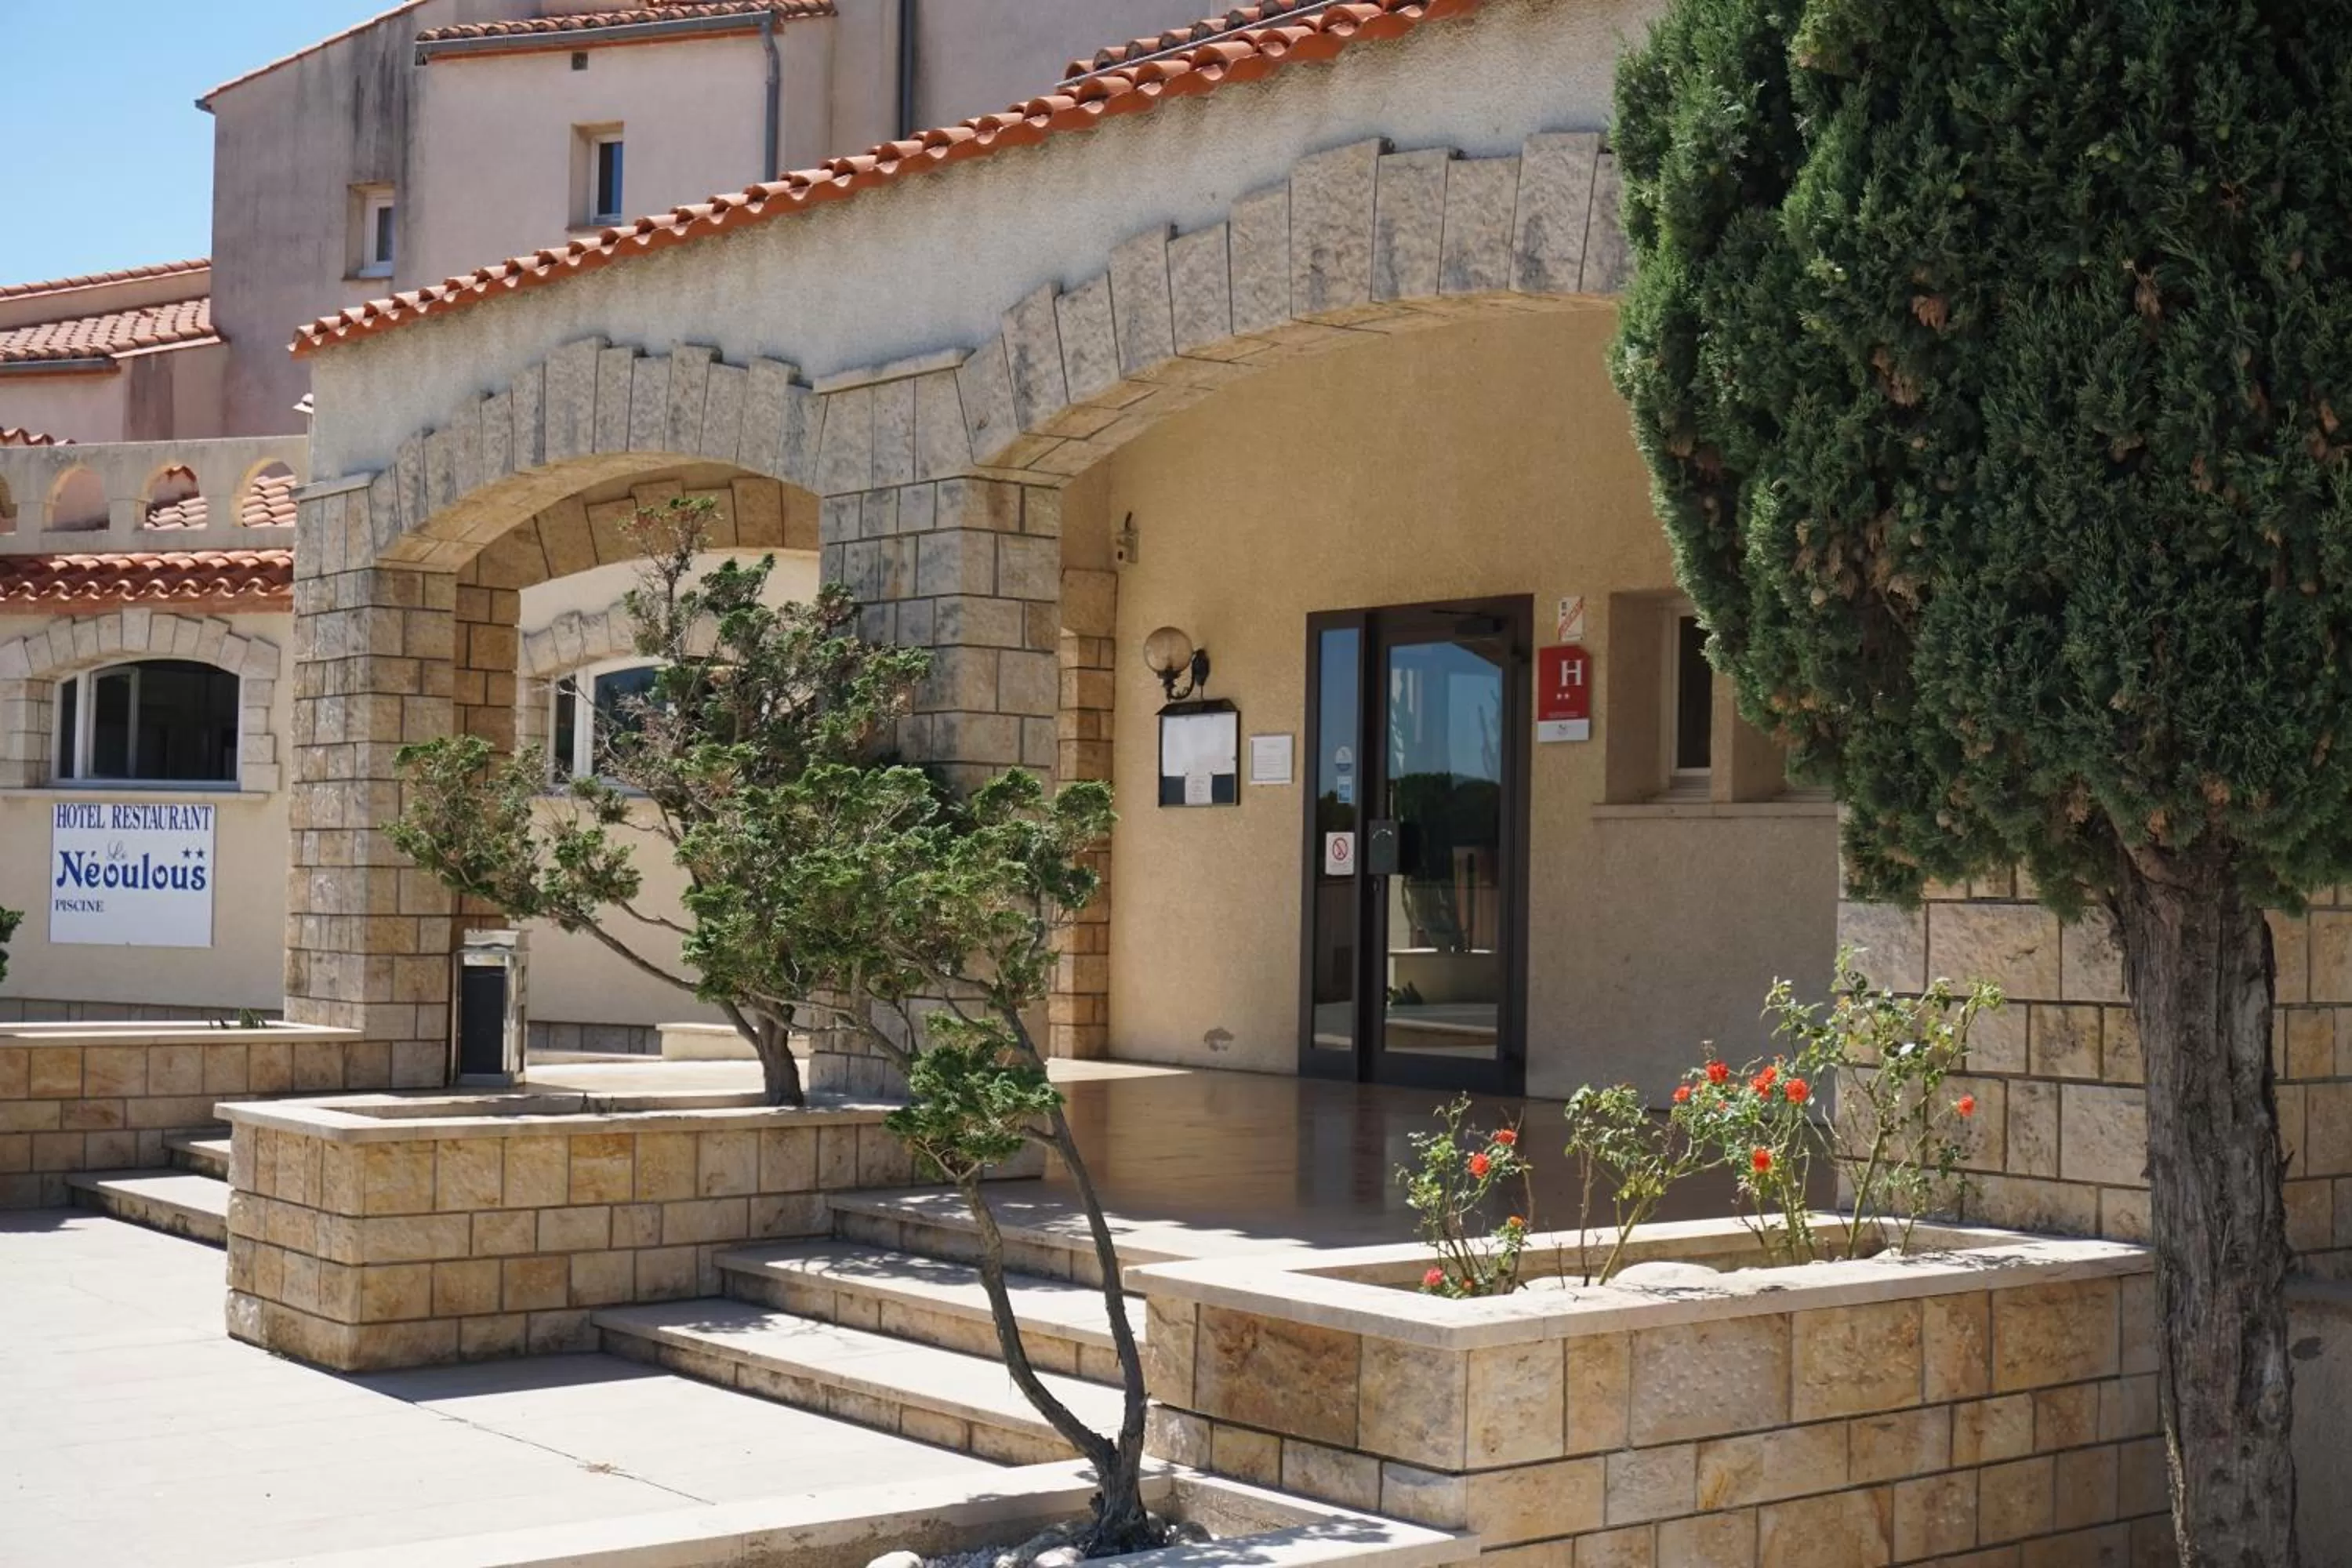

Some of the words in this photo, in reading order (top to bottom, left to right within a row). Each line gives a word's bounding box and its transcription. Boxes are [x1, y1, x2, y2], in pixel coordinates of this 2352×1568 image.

[1560, 659, 1583, 687] H
[56, 804, 105, 829] HOTEL
[111, 804, 212, 831] RESTAURANT
[56, 850, 206, 891] Néoulous
[55, 899, 104, 913] PISCINE
